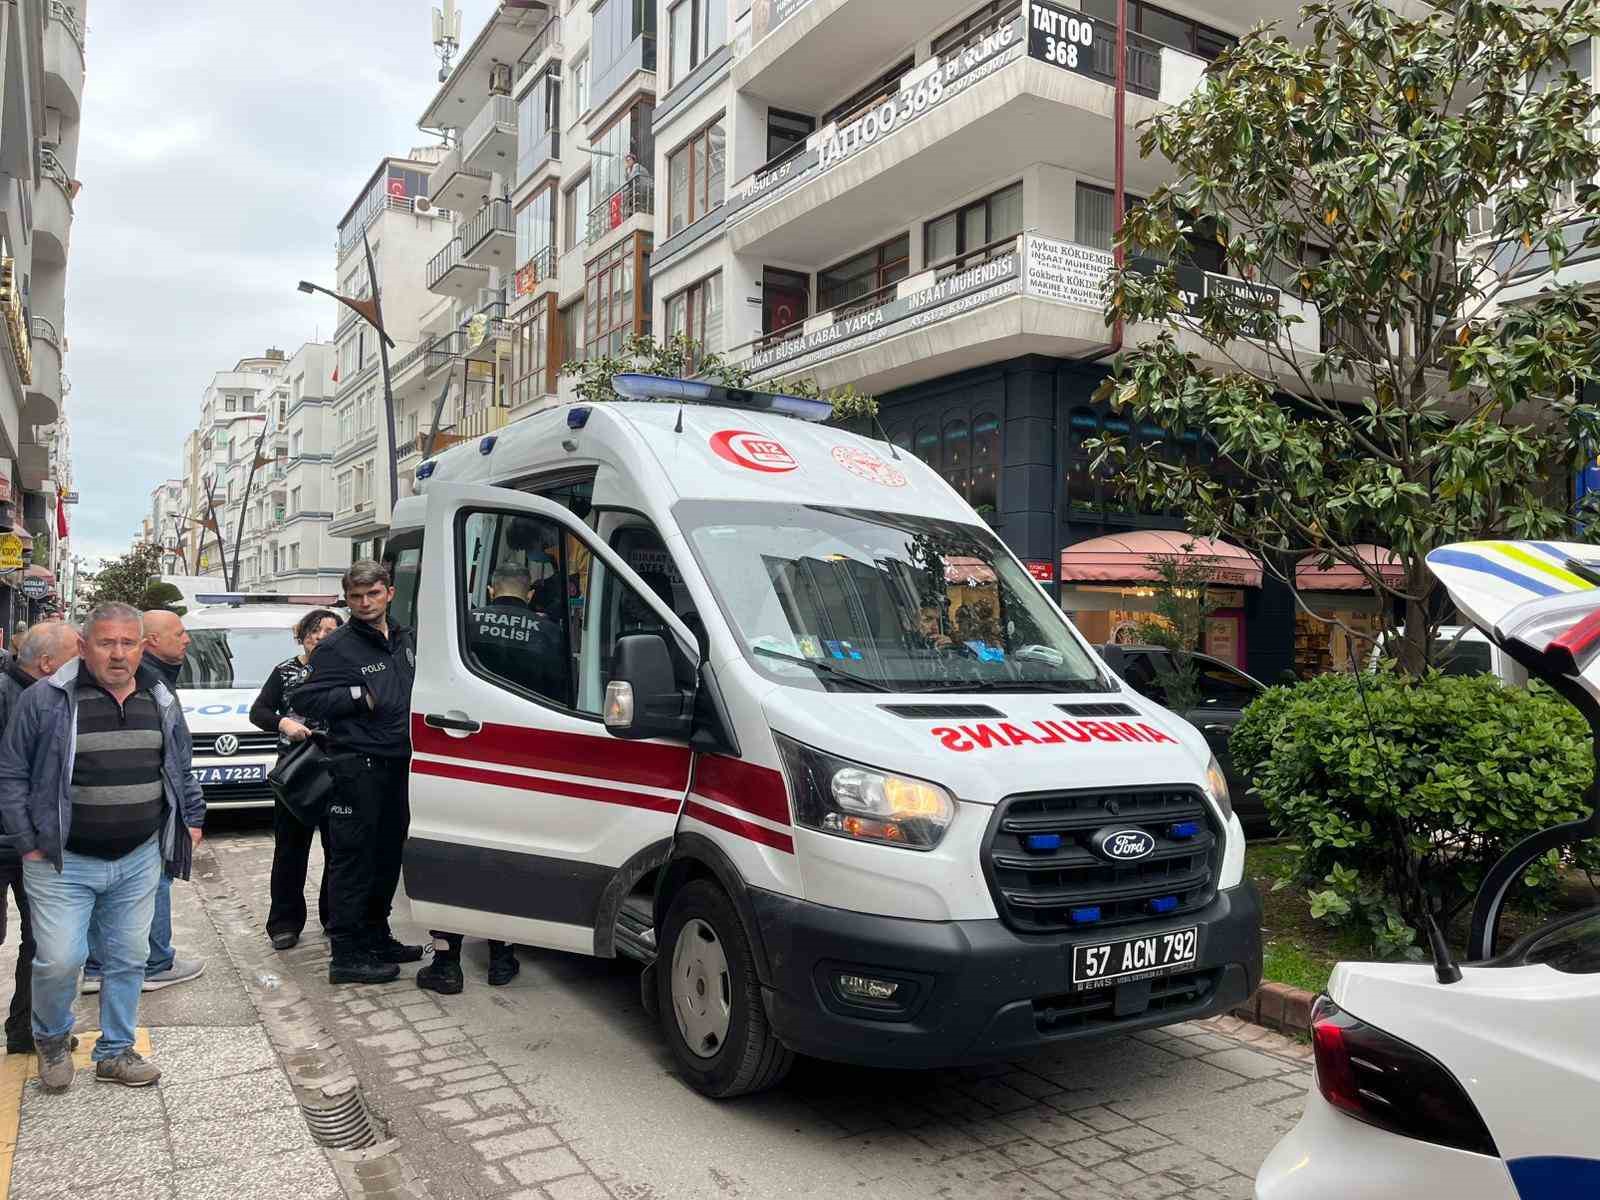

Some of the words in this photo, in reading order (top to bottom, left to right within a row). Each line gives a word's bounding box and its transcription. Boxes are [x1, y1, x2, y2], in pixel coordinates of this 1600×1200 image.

[1031, 4, 1093, 46] TATTOO
[1045, 36, 1078, 68] 368
[816, 101, 897, 172] TATTOO
[900, 70, 944, 120] 368
[1031, 240, 1058, 253] Aykut
[808, 326, 842, 348] KABAL
[845, 309, 884, 335] YAPÇA
[472, 612, 541, 632] TRAFİK
[480, 624, 531, 642] POLİSİ
[211, 768, 222, 781] A
[225, 767, 261, 780] 7222
[1112, 834, 1146, 855] Ford
[1086, 945, 1111, 977] 57
[1122, 938, 1157, 971] ACN
[1163, 930, 1194, 963] 792
